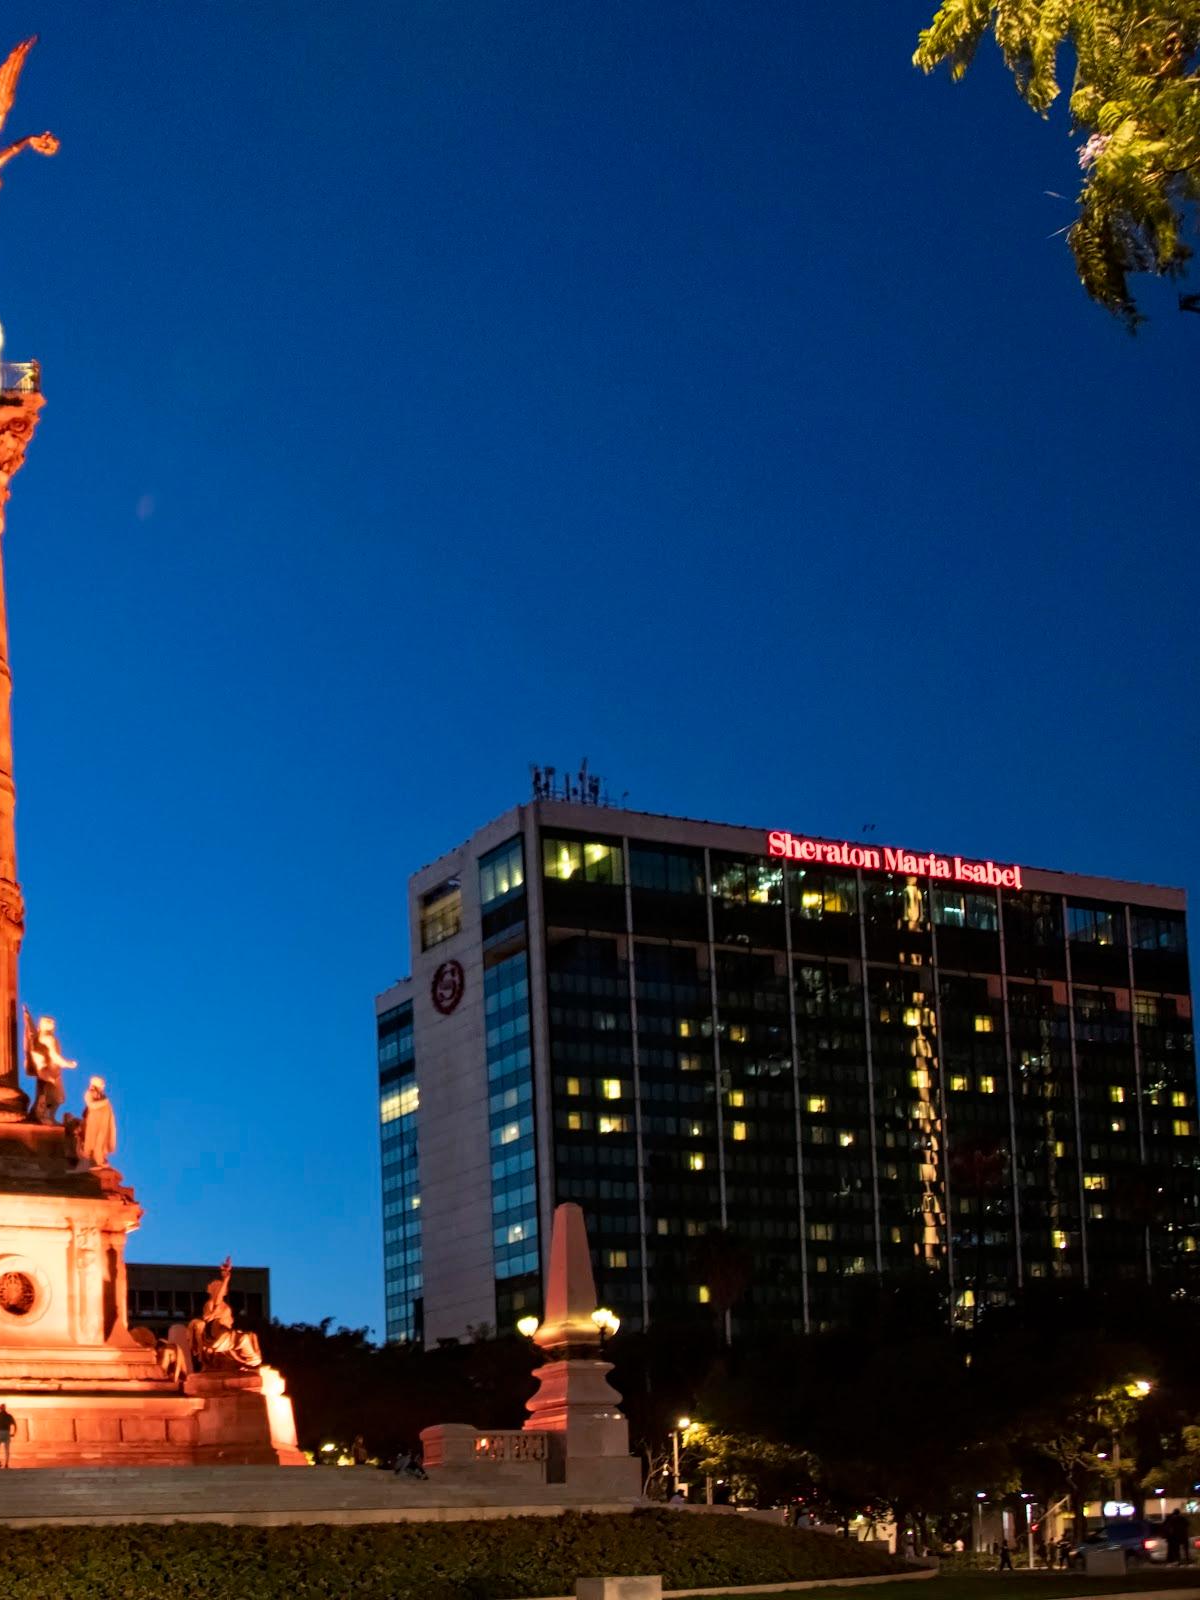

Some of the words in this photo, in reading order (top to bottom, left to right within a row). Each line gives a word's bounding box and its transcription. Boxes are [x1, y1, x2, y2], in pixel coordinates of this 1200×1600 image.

[768, 831, 880, 868] Sheraton
[884, 847, 950, 879] Maria
[954, 857, 1023, 889] Isabel
